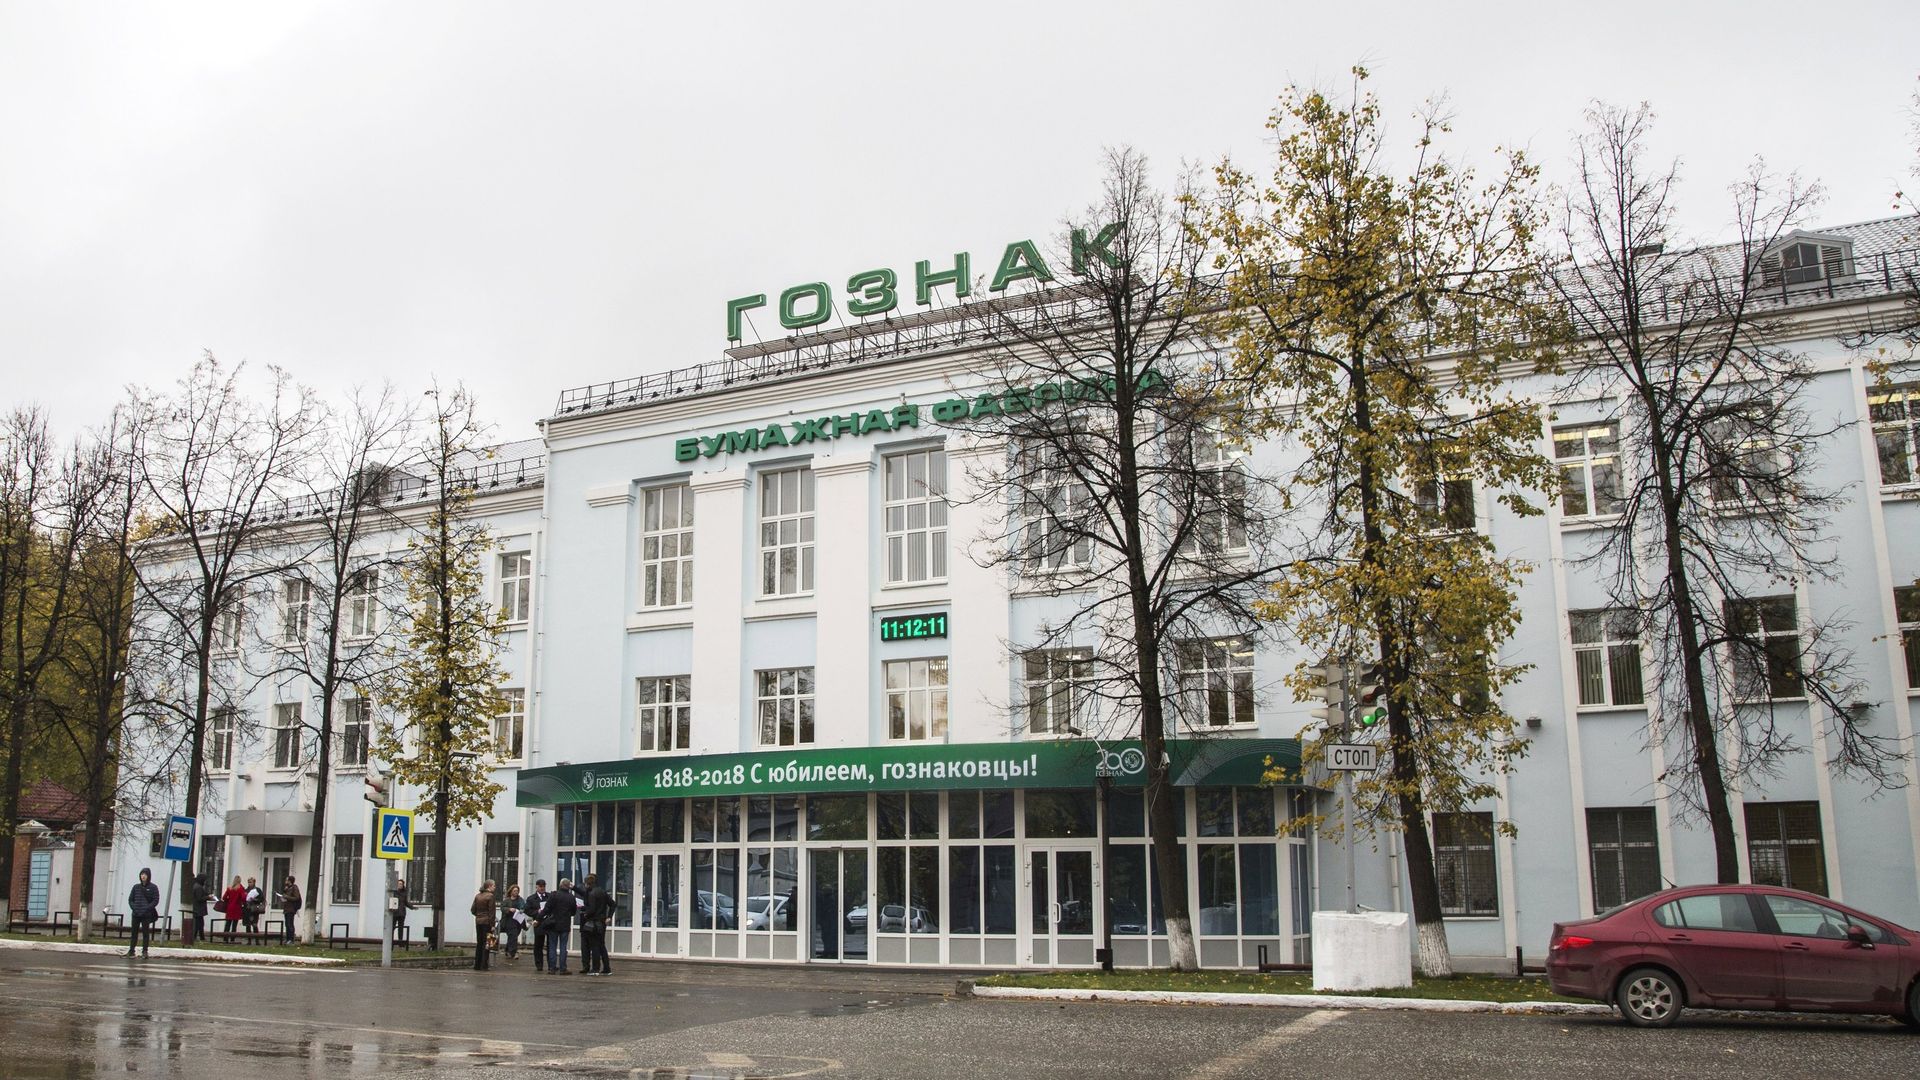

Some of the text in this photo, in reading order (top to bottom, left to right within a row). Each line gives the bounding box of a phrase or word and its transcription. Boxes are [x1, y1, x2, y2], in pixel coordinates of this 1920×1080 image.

[727, 221, 1130, 342] ГОЗНАК
[675, 404, 919, 462] БУМАЖНАЯ
[881, 616, 945, 639] 11:12:11
[654, 754, 1037, 788] 1818-2018 С юбилеем, гознаковцы!
[1335, 749, 1370, 766] СТОП
[596, 776, 629, 788] ГОЗНАК
